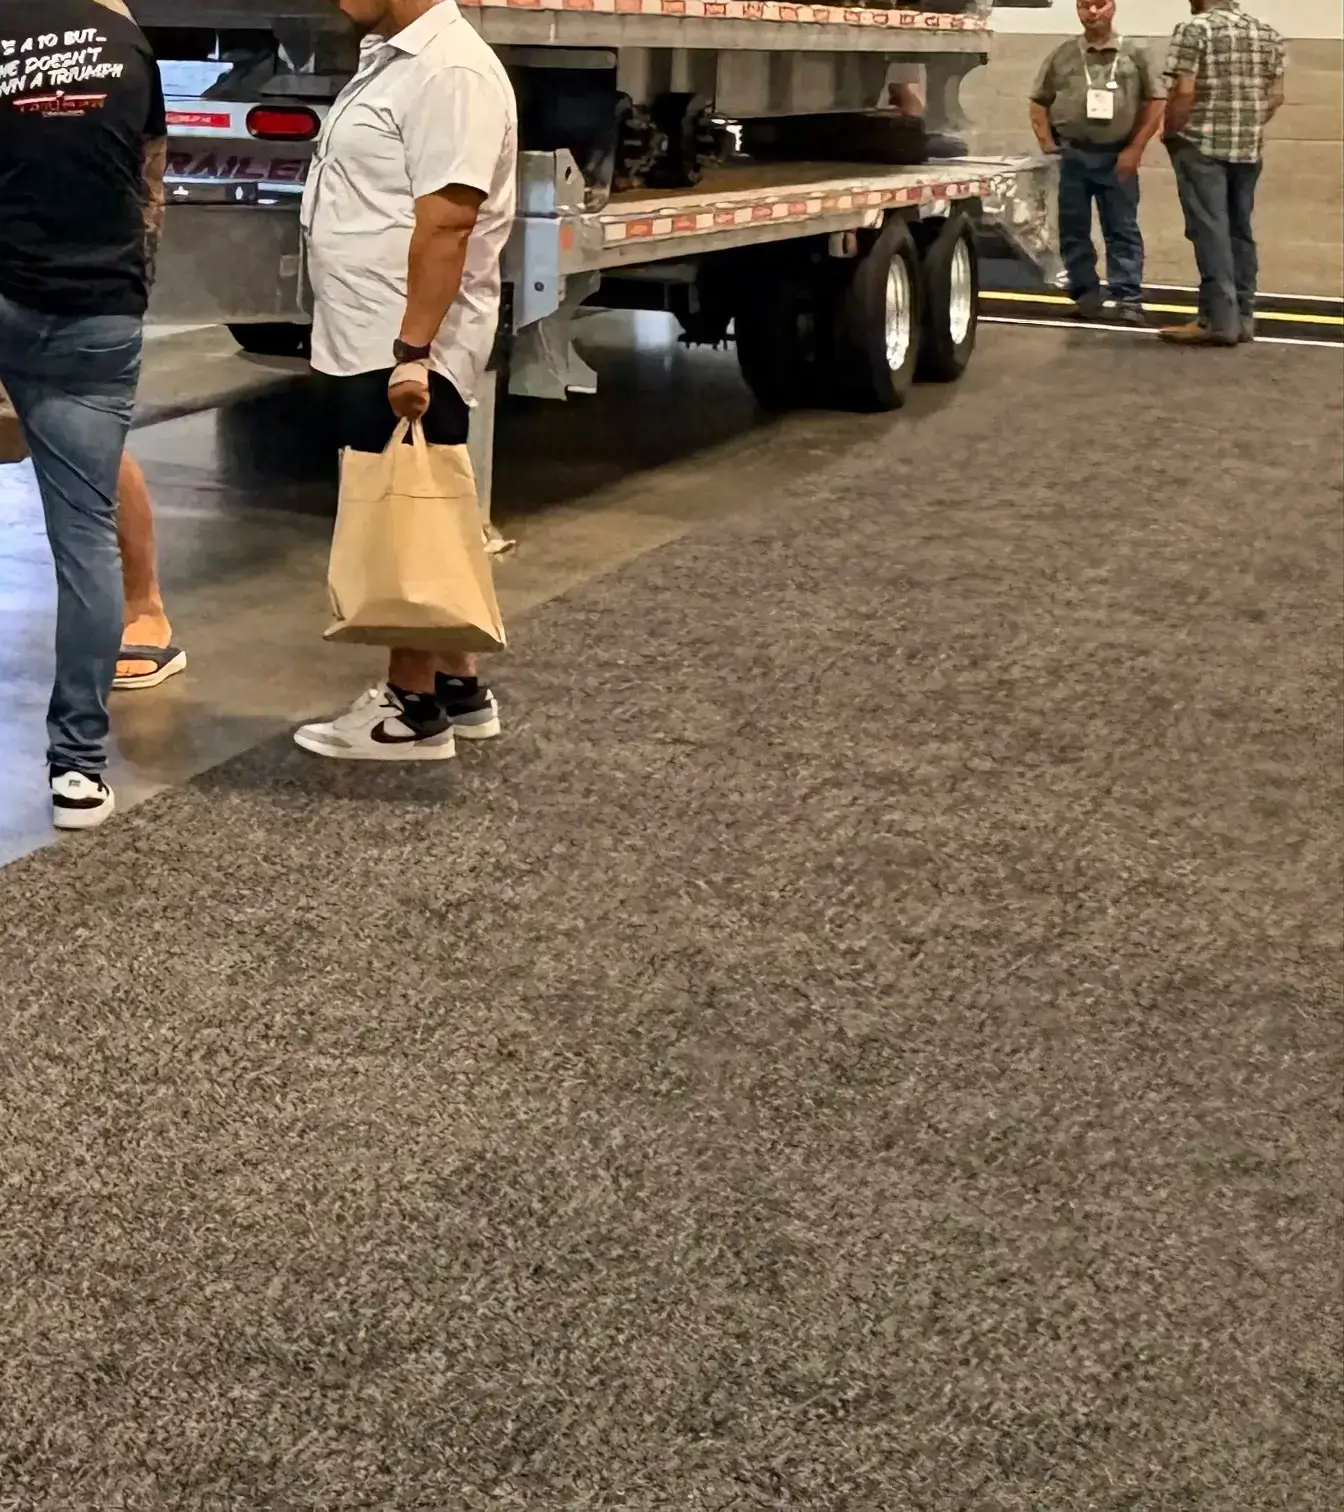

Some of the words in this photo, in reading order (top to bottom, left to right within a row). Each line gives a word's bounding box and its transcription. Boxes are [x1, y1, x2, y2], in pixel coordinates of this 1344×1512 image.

[20, 37, 33, 53] A
[37, 33, 59, 50] 10
[29, 72, 44, 90] A
[165, 151, 311, 181] RAILE
